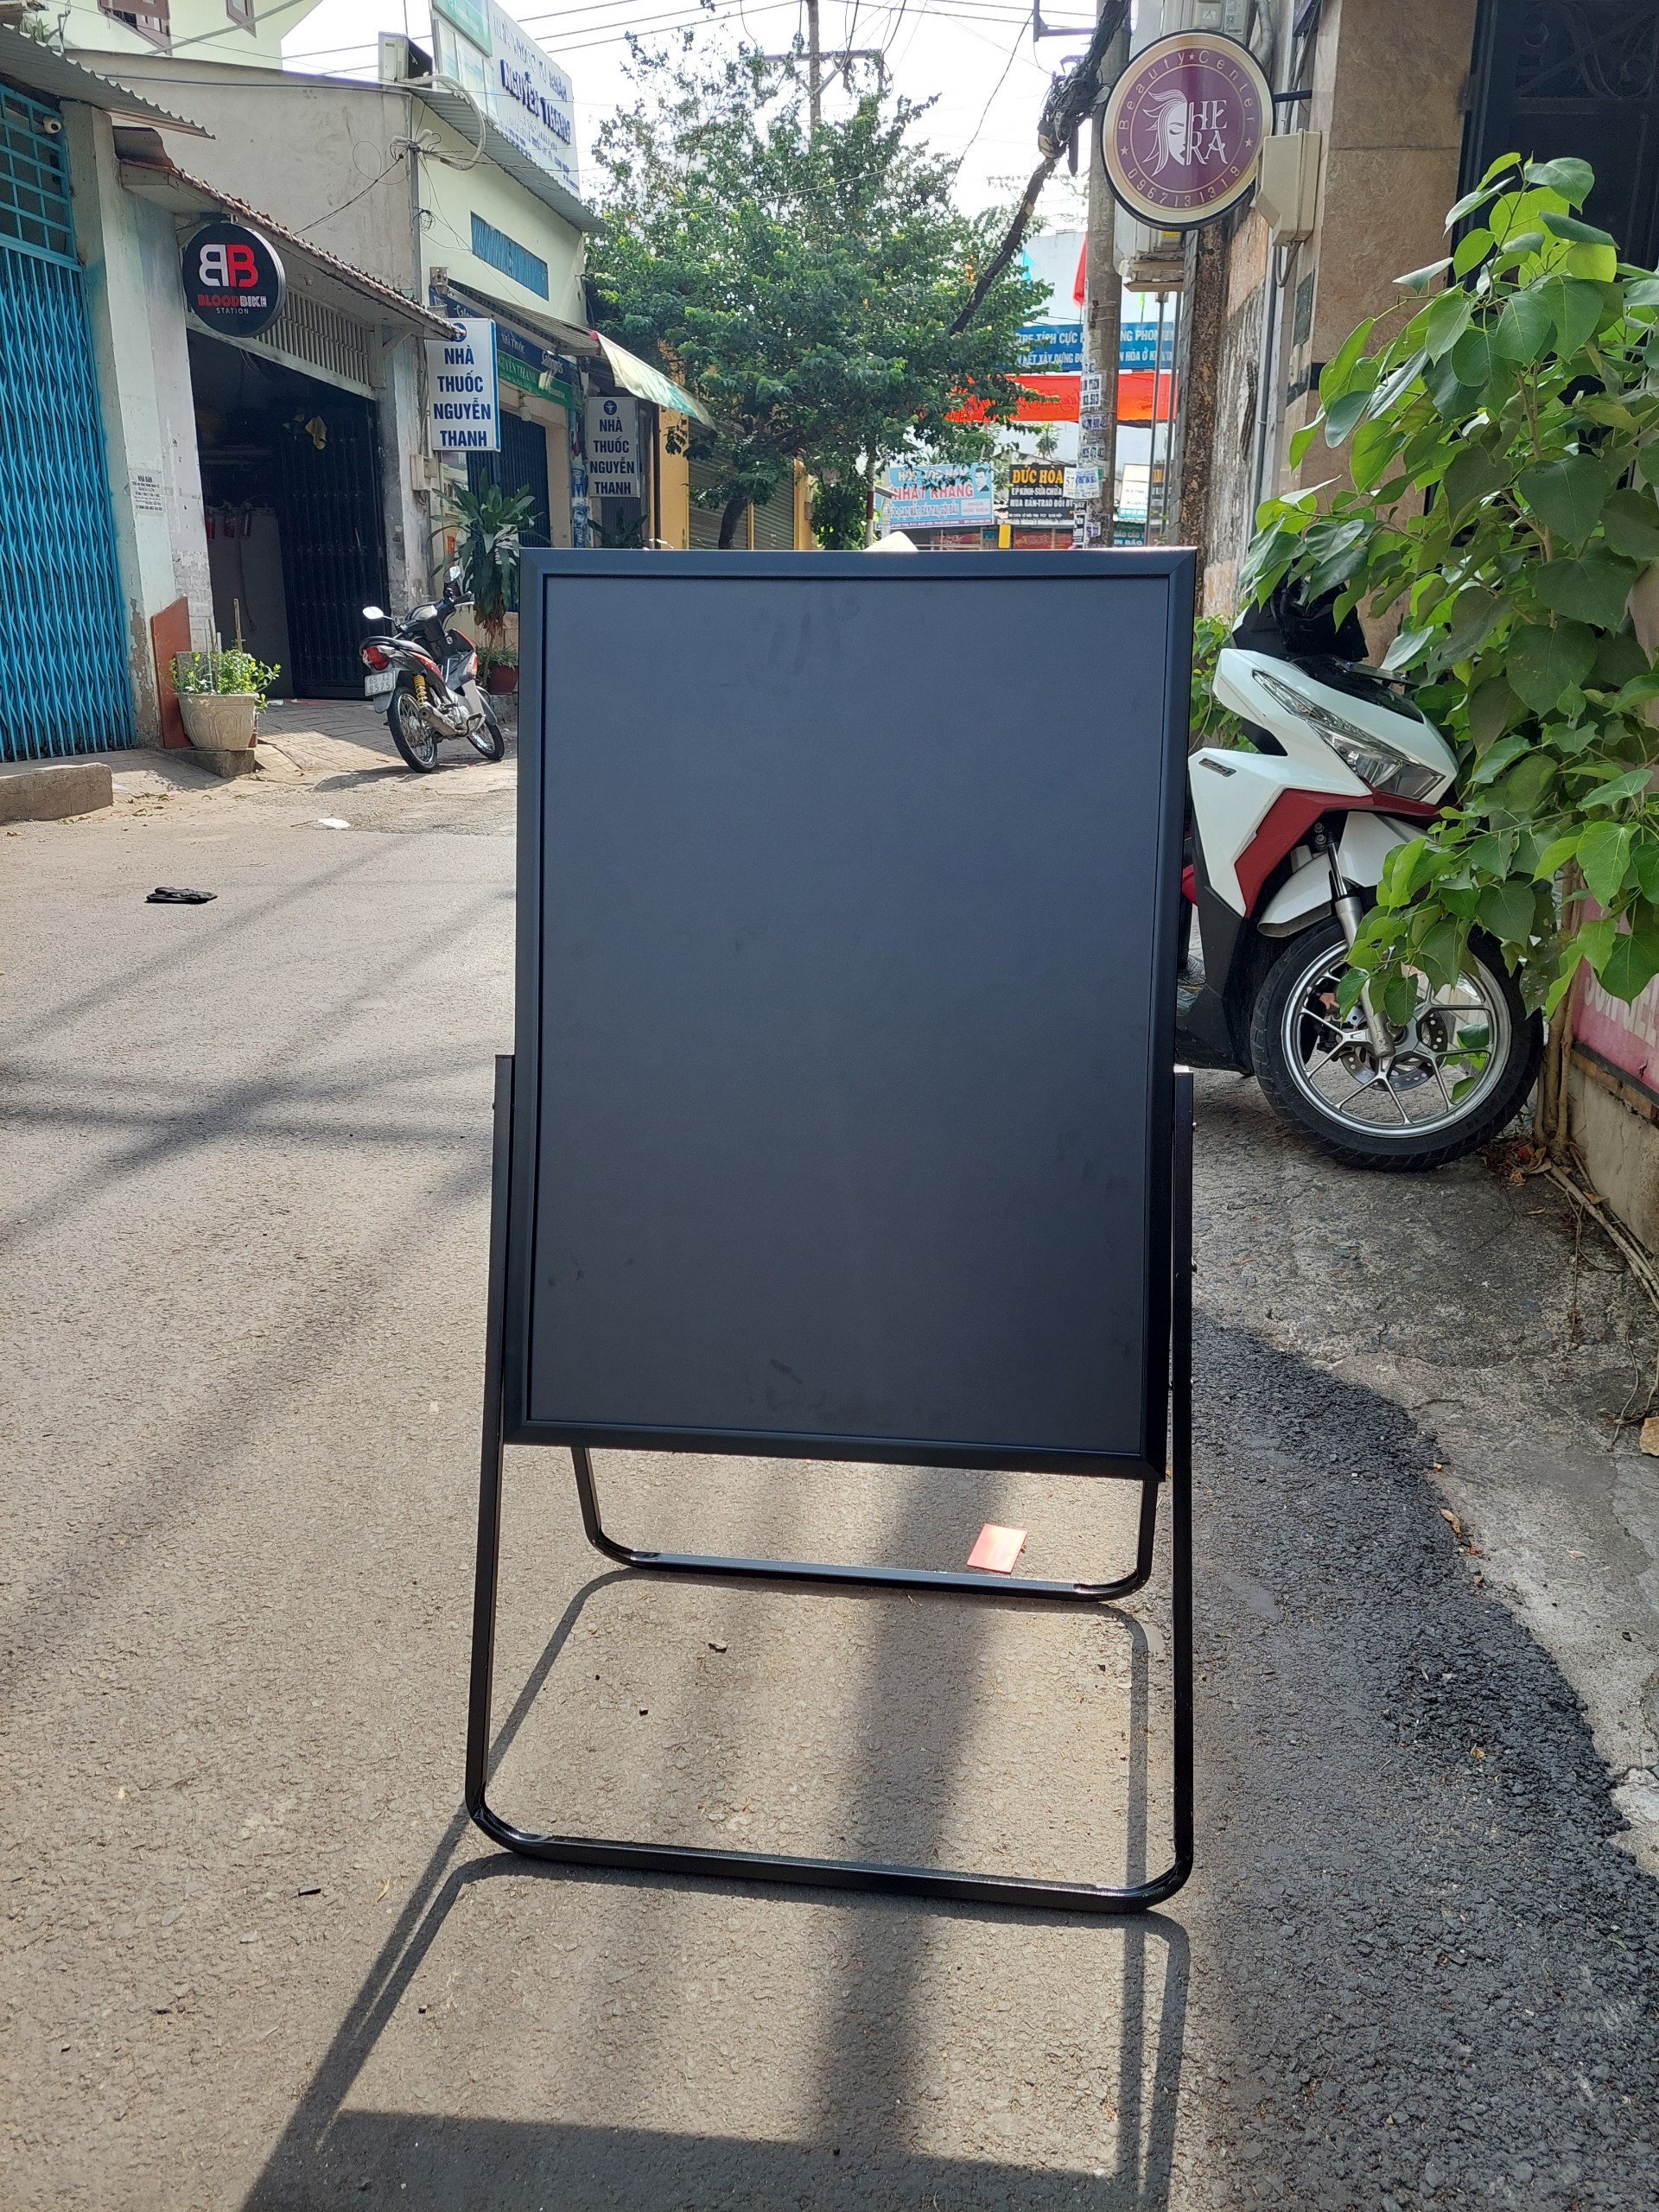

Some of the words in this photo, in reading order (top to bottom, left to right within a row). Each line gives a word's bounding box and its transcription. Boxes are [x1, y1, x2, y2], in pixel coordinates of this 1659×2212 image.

[1118, 51, 1185, 130] Beauty
[1198, 50, 1255, 123] Center
[1126, 165, 1241, 207] 0967131319
[444, 345, 474, 365] NHÀ
[437, 370, 484, 392] THUỐC
[434, 397, 492, 420] NGUYỄN
[599, 416, 623, 432] NHÀ
[440, 430, 487, 447] THANH
[594, 436, 630, 454] THUỐC
[590, 457, 635, 474] NGUYỄN
[1012, 465, 1037, 484] ĐỨC
[1039, 465, 1064, 484] HÒA
[594, 481, 632, 494] THANH
[931, 482, 975, 499] KHANG
